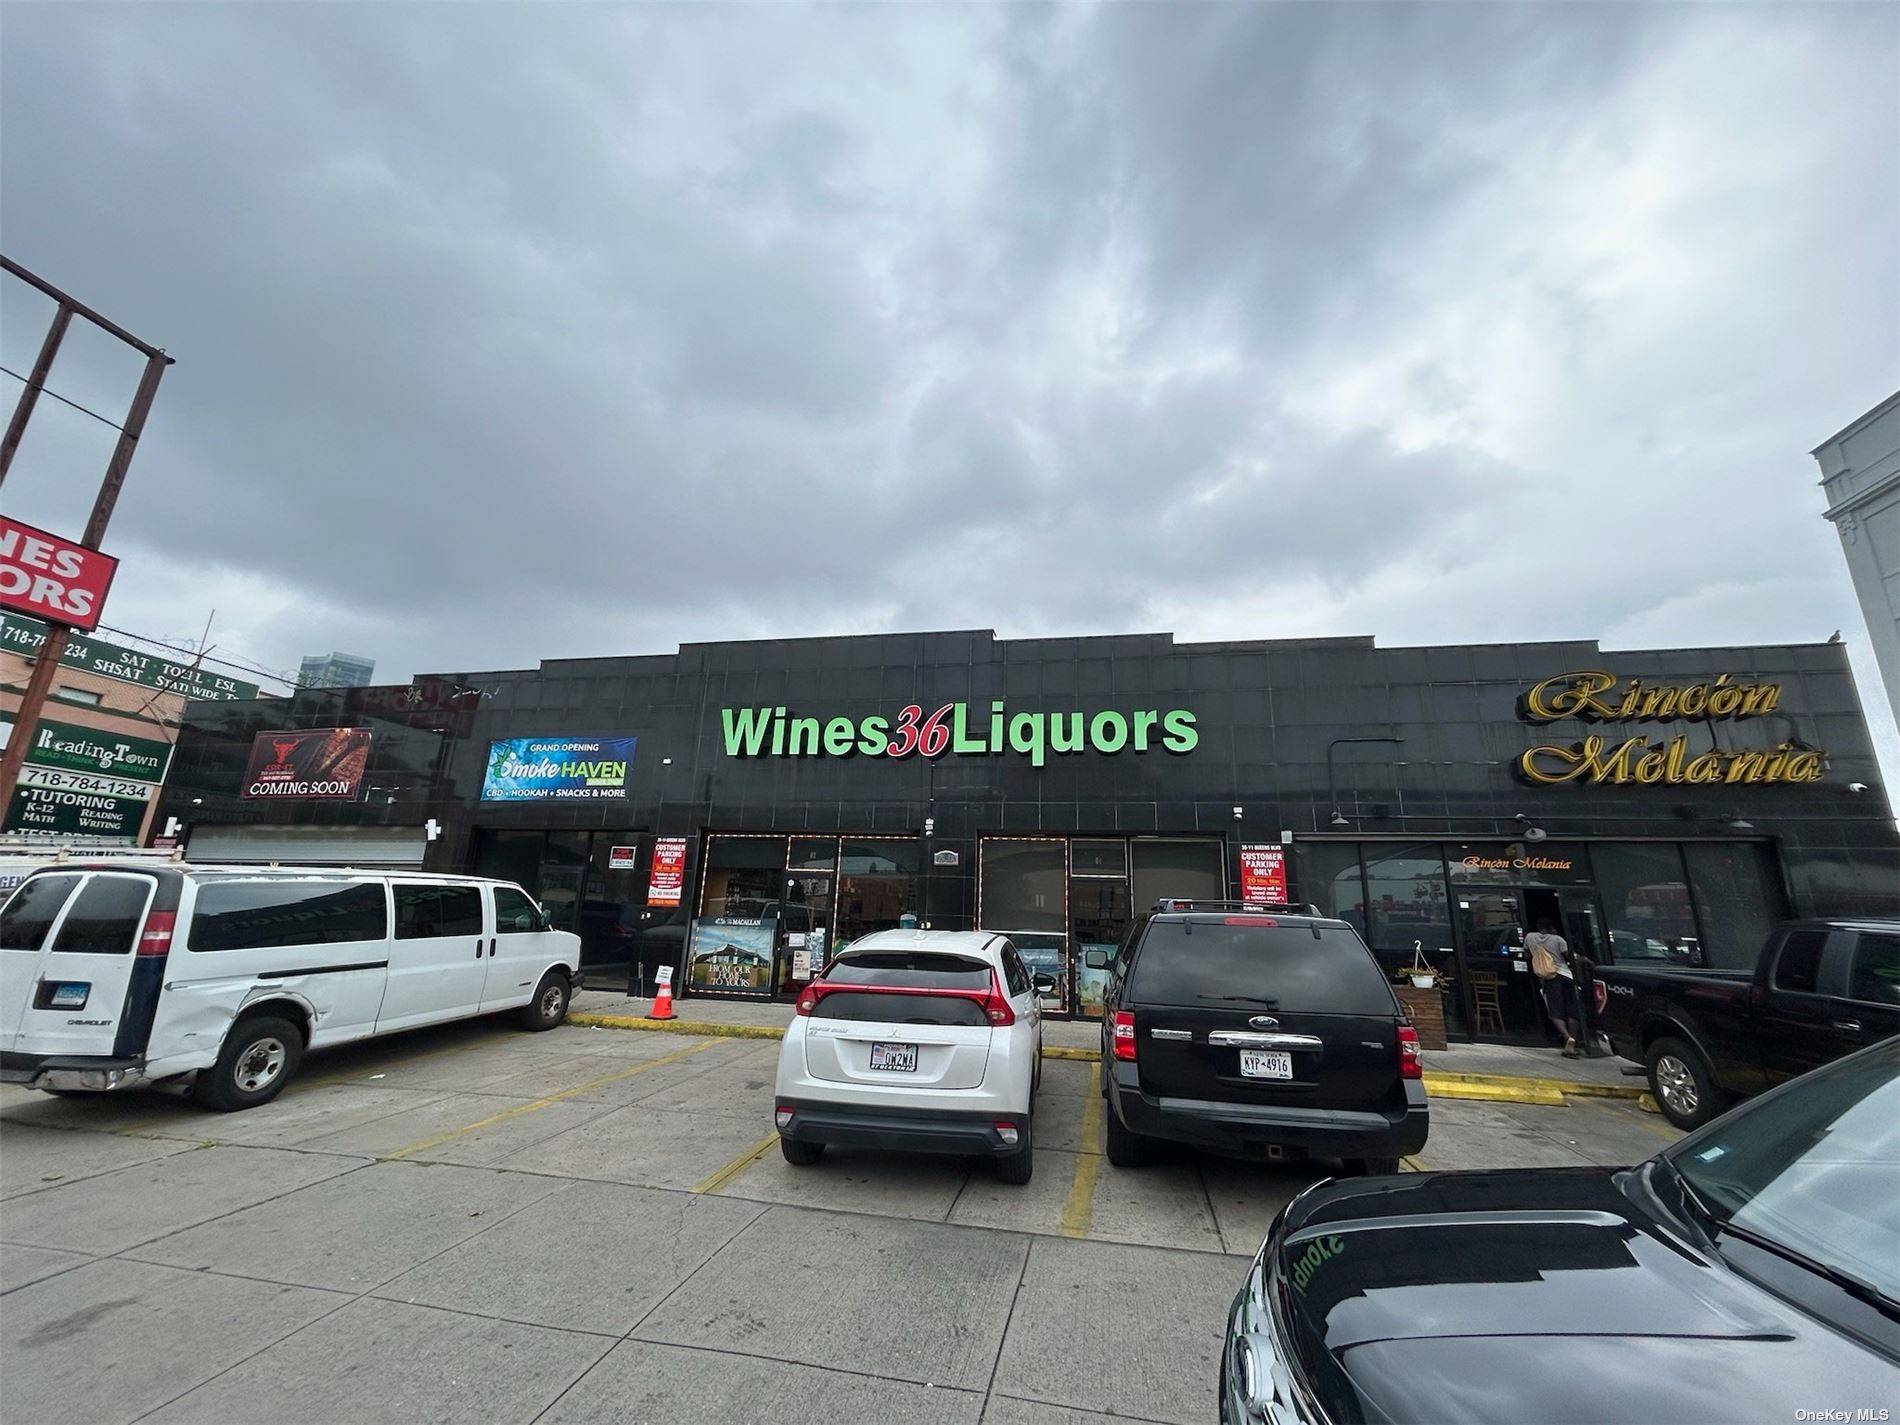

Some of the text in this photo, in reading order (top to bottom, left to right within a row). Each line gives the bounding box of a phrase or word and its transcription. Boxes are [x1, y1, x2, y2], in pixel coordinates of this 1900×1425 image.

[93, 659, 144, 680] SHSAT
[120, 652, 150, 669] SAT
[214, 678, 237, 692] ESL
[1528, 670, 1782, 719] Rincón
[721, 701, 1200, 767] Wines 36 Liquors
[530, 743, 600, 752] GRAND OPENING
[500, 752, 626, 778] Smoke HAVEN
[1521, 735, 1827, 784] Melania
[28, 770, 147, 797] 718-784-1234
[250, 781, 350, 795] COMING SOON
[486, 788, 626, 797] CBD HOOKAH SNACKS & MORE
[31, 790, 116, 810] TUTORING
[26, 803, 54, 814] K-12
[1241, 852, 1282, 860] CUSTOMER
[1513, 856, 1572, 870] Melania
[1246, 860, 1280, 868] PARKING
[1253, 868, 1272, 876] ONLY
[709, 964, 751, 974] FROM OUR
[711, 978, 750, 987] TO YOURS
